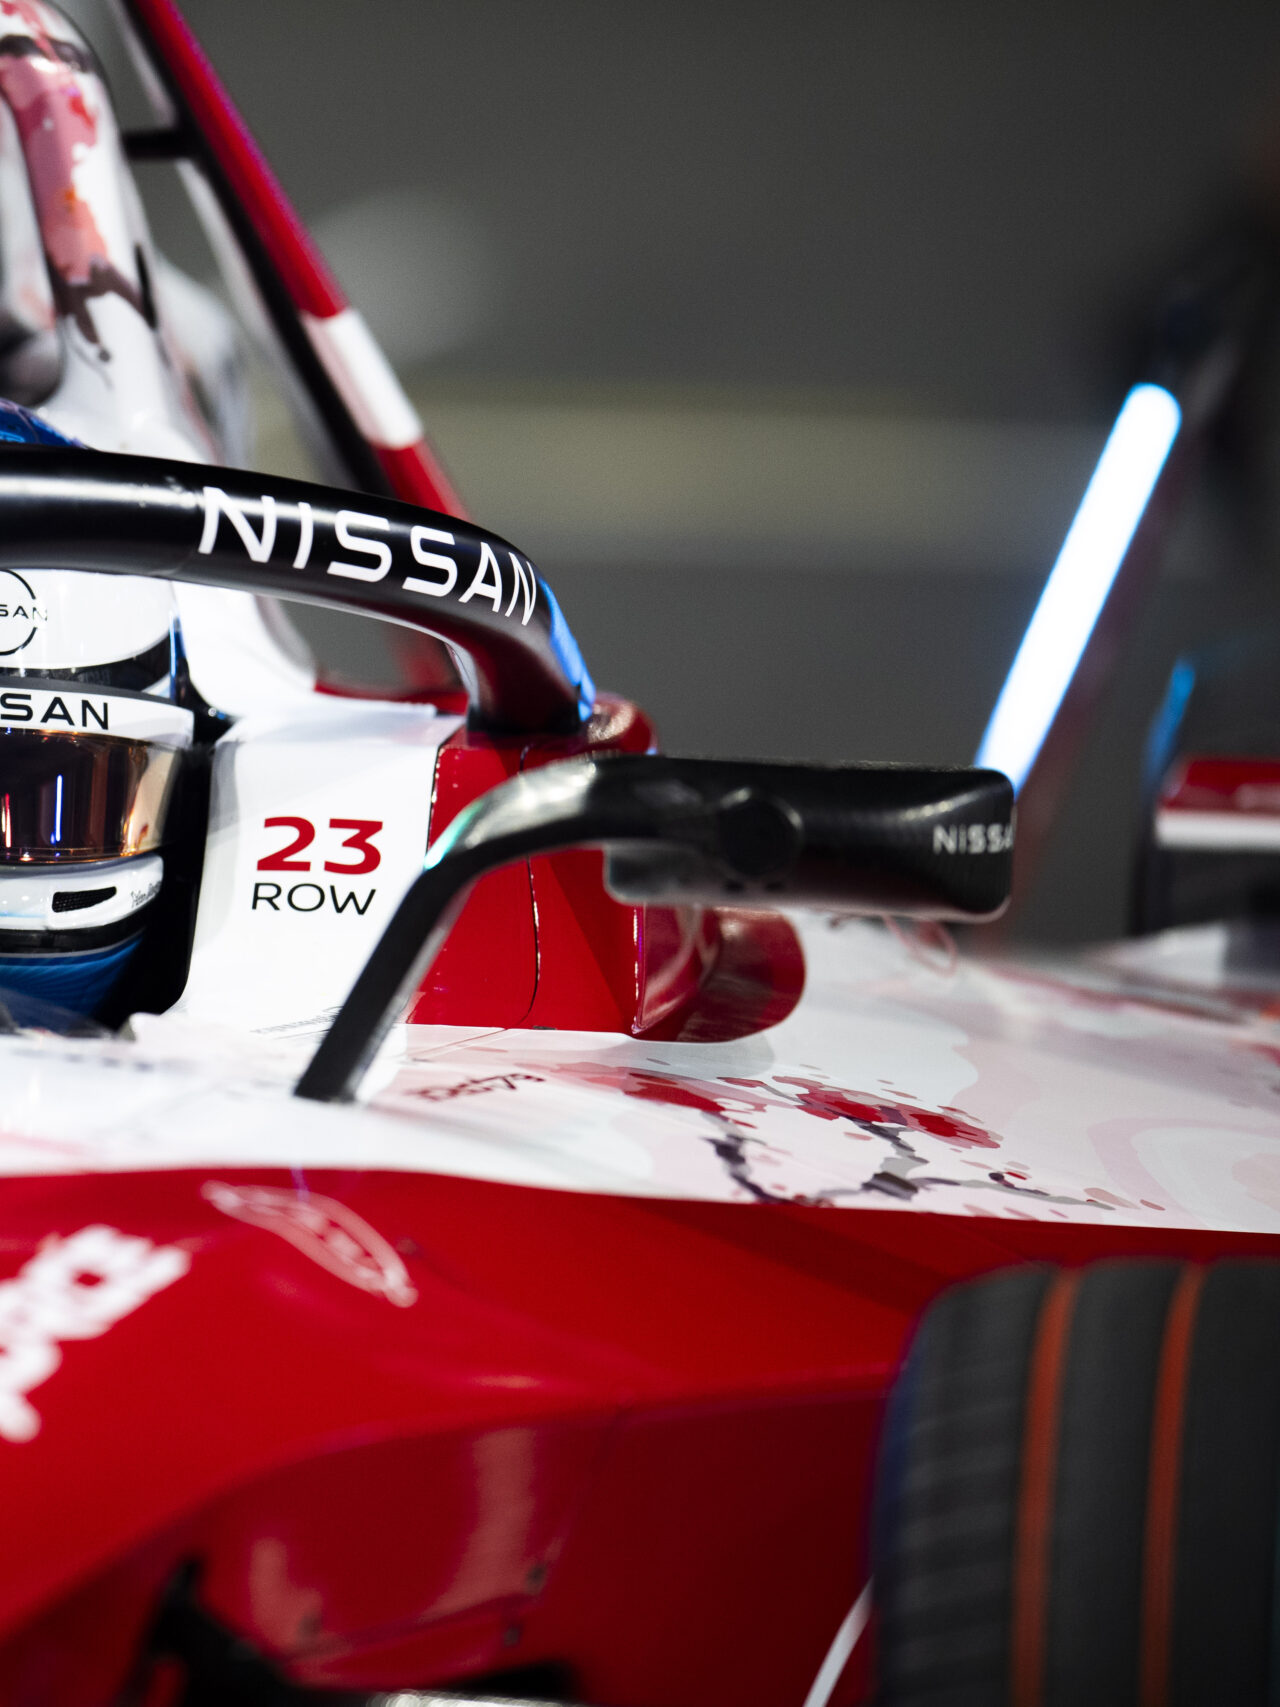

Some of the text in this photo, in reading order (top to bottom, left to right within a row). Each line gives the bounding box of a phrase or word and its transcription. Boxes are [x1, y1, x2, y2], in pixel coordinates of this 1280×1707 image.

[198, 486, 538, 626] NISSAN
[256, 816, 384, 875] 23
[251, 882, 377, 915] ROW
